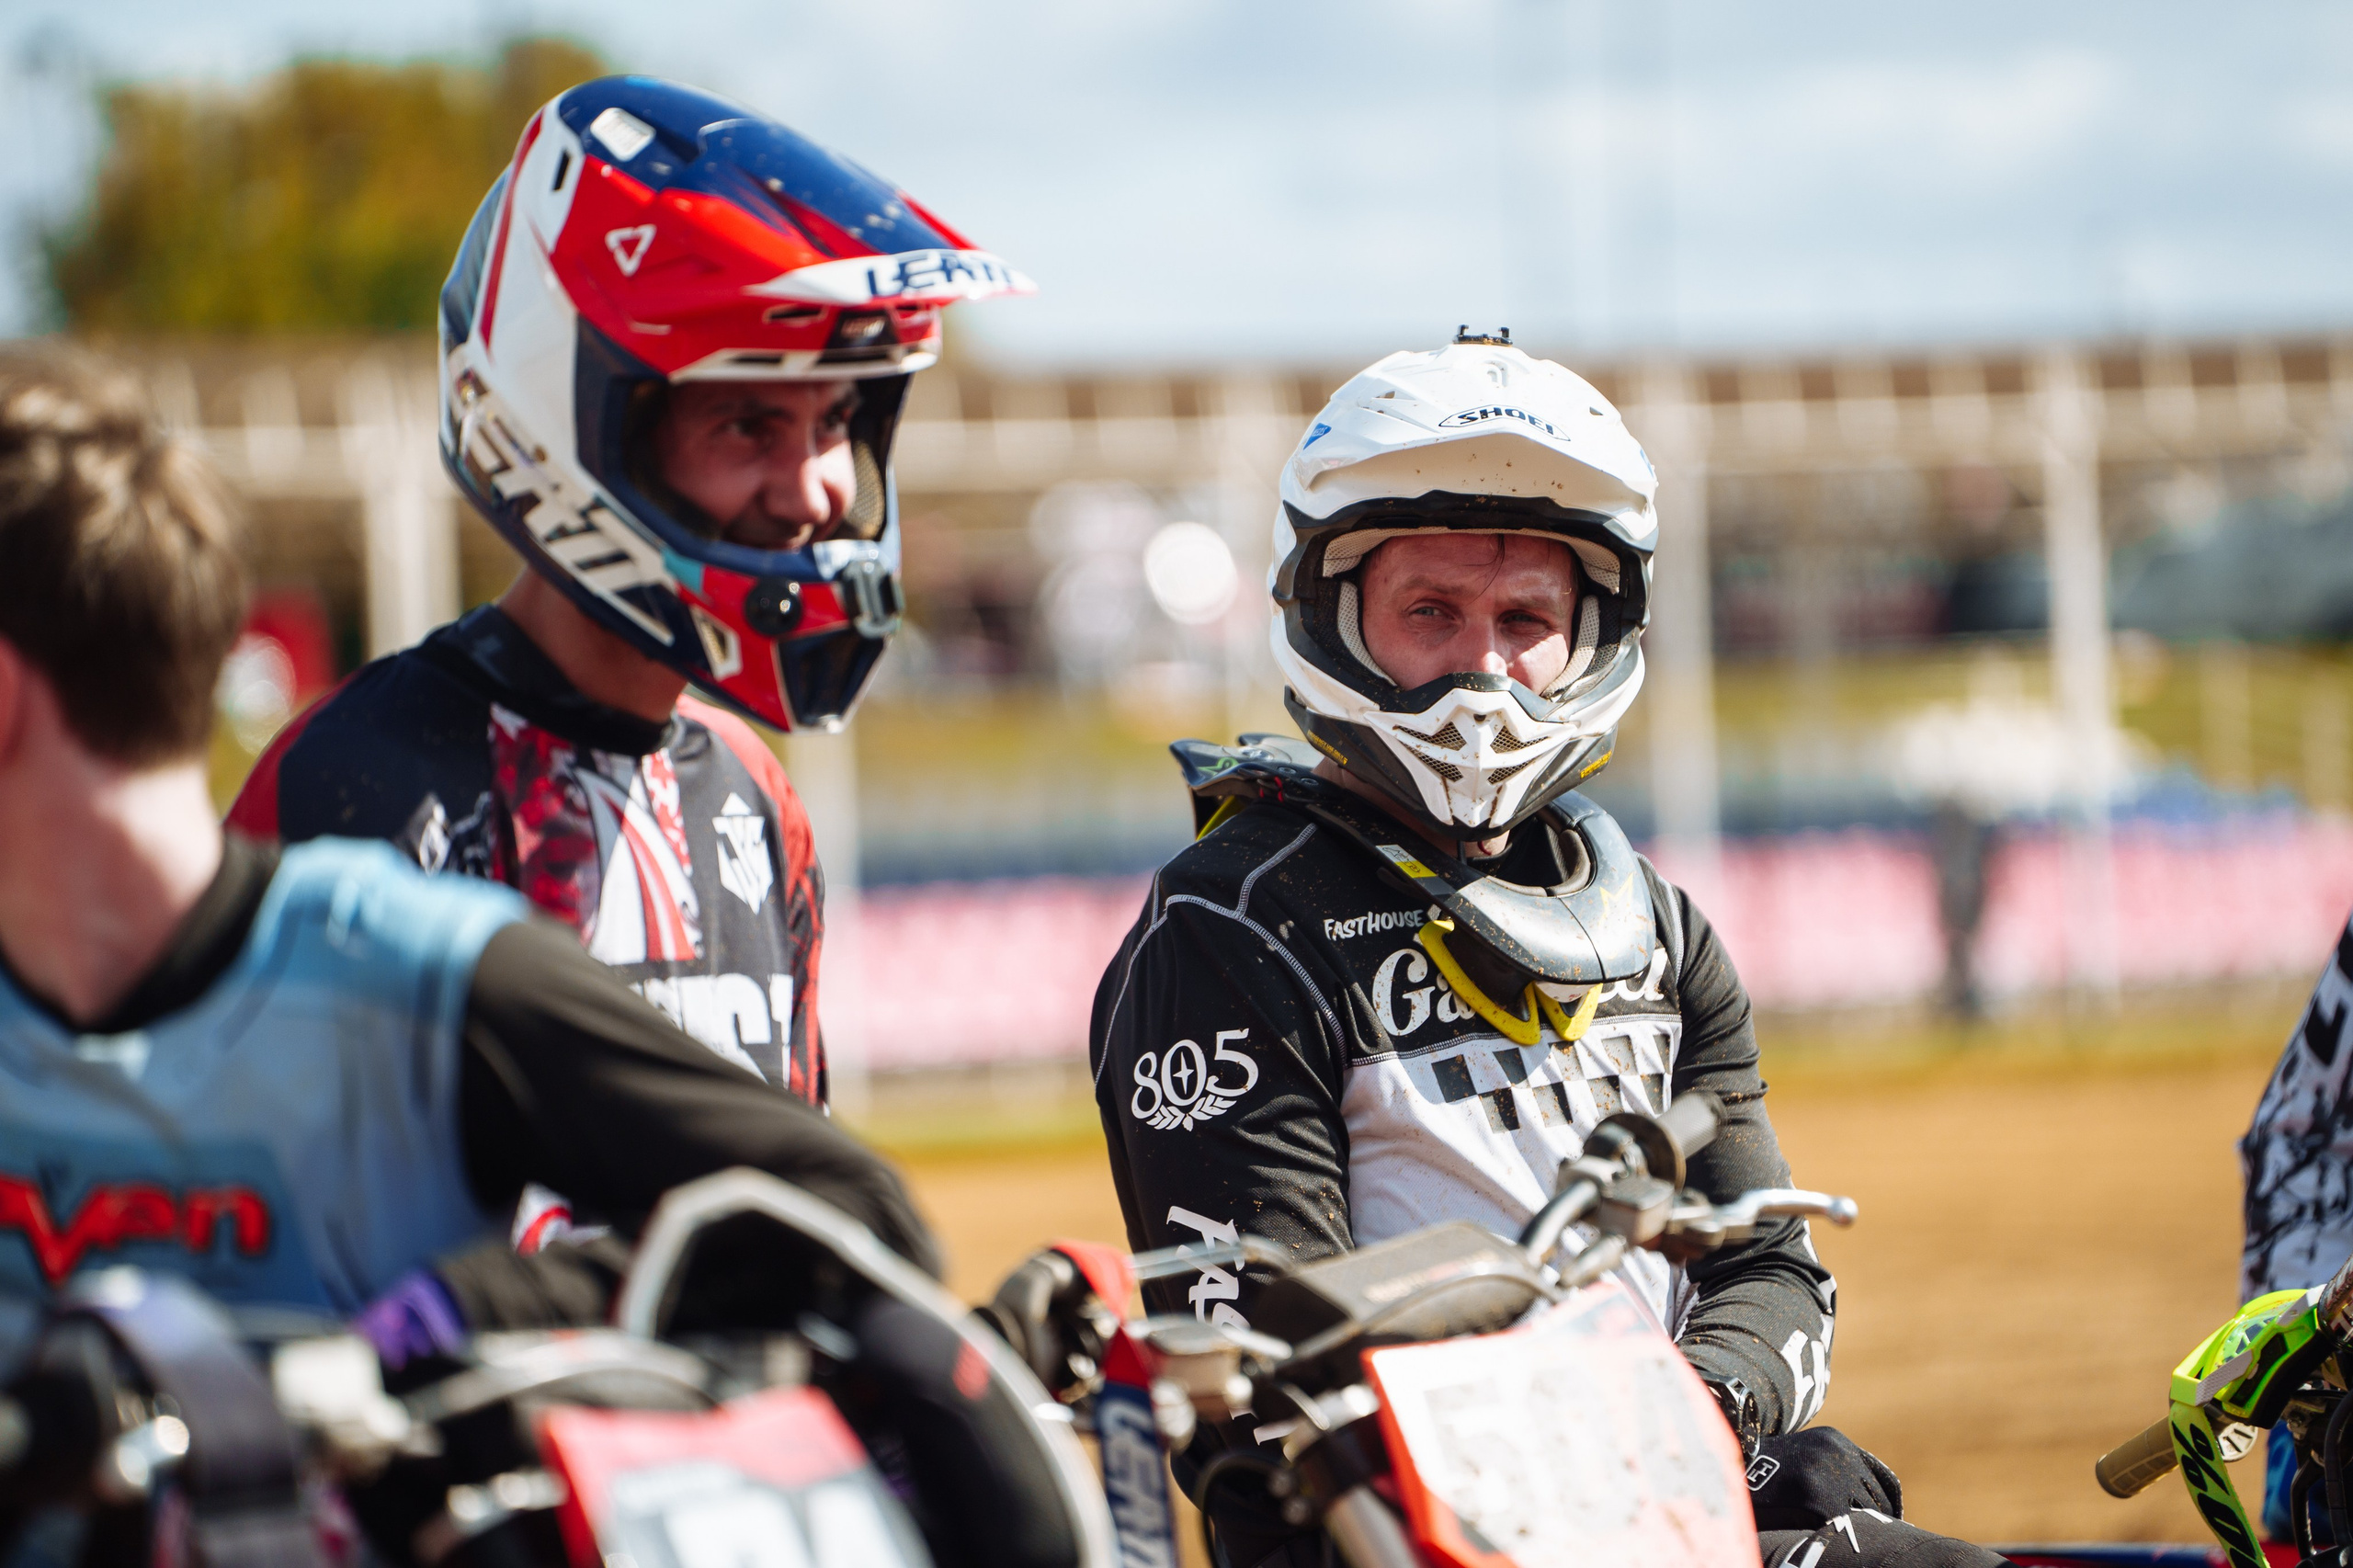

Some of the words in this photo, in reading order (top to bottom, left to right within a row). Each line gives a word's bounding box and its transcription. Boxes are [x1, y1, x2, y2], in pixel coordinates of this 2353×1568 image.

[1458, 406, 1554, 436] SHOEI
[1324, 909, 1425, 941] FASTHOUSE
[1131, 1028, 1259, 1119] 805
